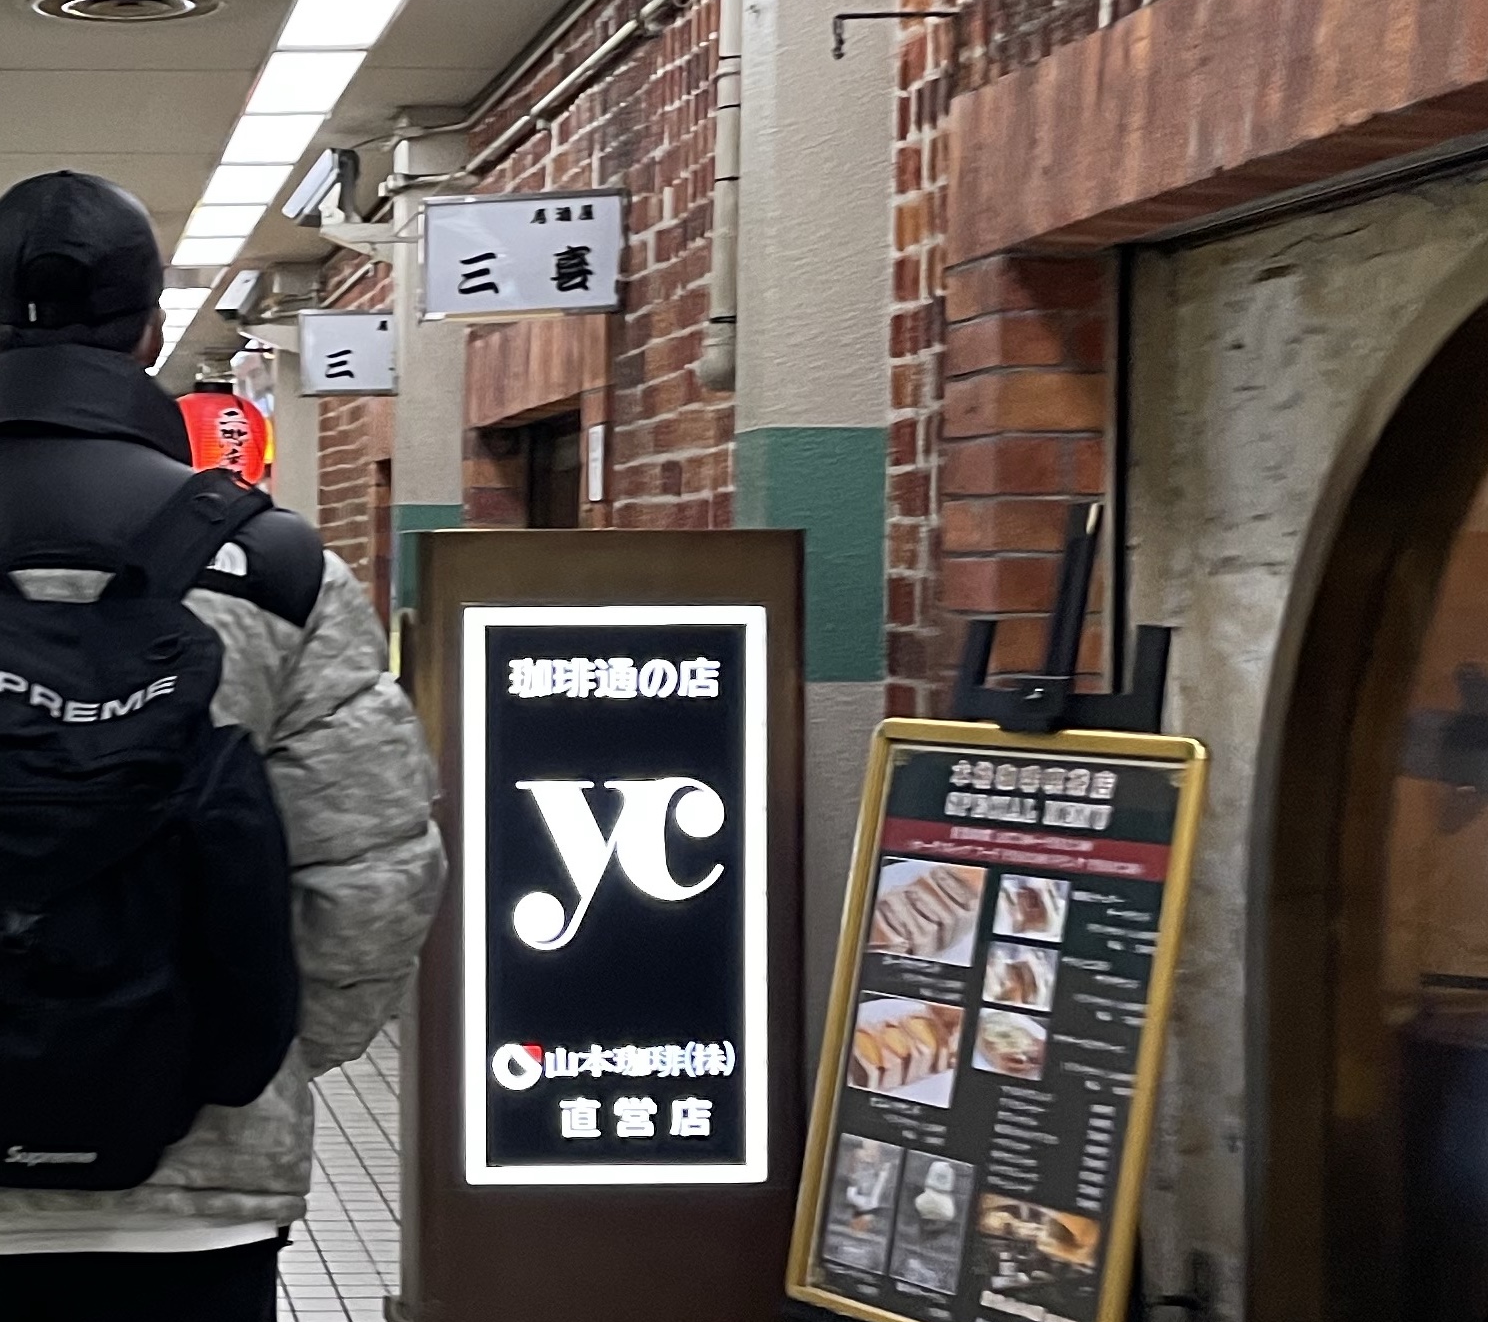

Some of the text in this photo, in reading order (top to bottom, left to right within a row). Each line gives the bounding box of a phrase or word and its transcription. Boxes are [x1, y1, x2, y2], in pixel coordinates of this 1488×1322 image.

[508, 657, 721, 699] 珈琲通の店
[559, 1097, 713, 1138] 直営店
